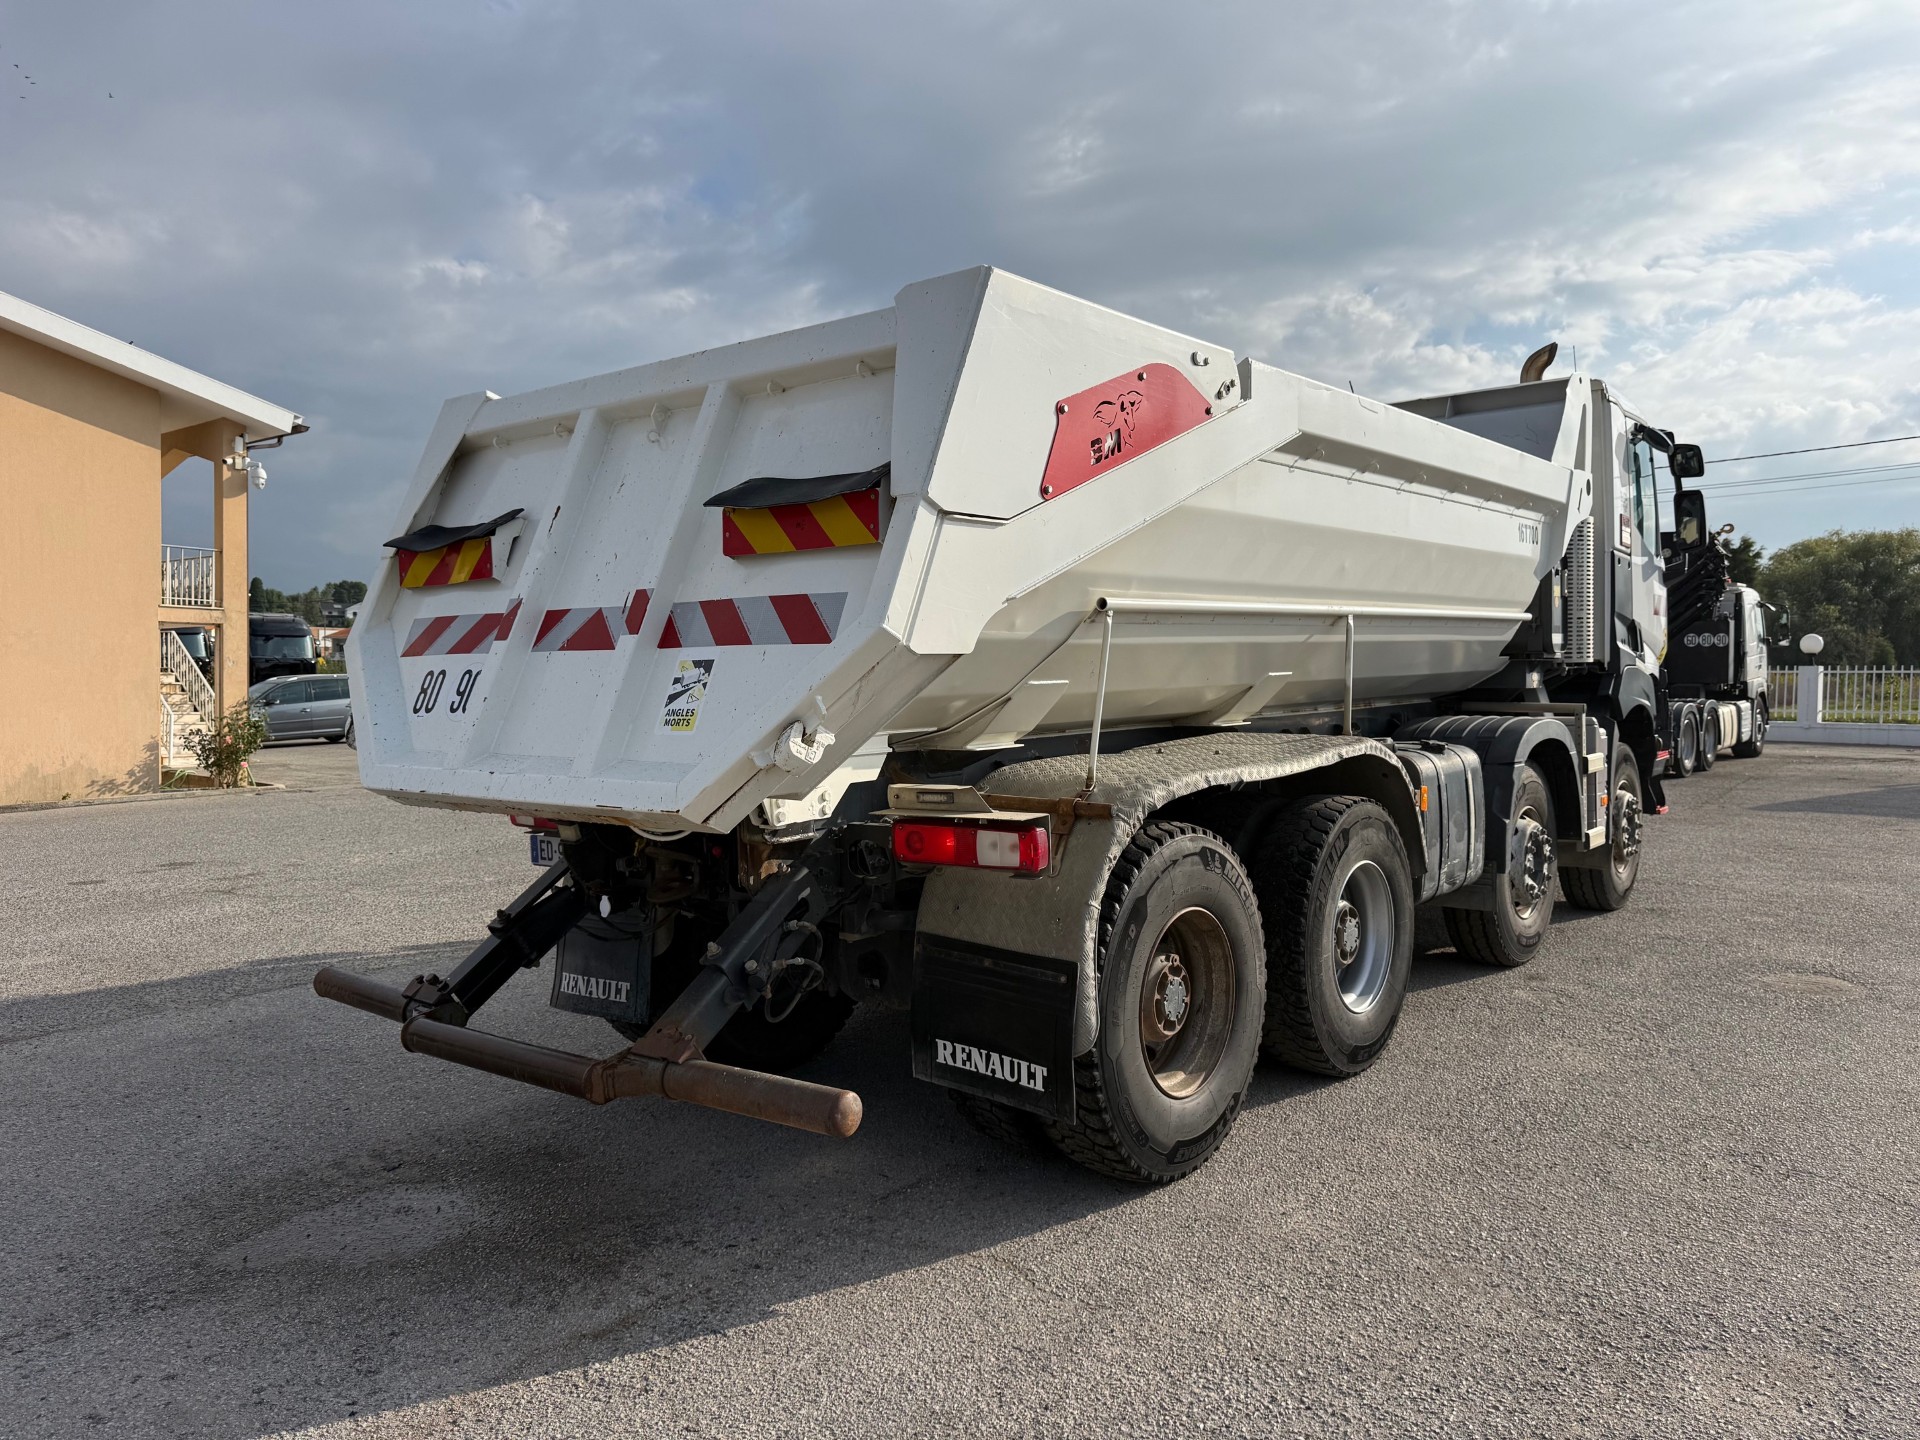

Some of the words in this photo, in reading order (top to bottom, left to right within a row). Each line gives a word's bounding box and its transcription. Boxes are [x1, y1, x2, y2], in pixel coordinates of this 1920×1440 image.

[1091, 428, 1122, 466] BM
[1686, 635, 1697, 646] 60
[1701, 634, 1712, 646] 80
[1716, 634, 1727, 646] 90
[413, 669, 447, 714] 80
[663, 718, 692, 727] MORTS
[664, 708, 696, 717] ANGLES
[560, 972, 631, 1003] RENAULT
[935, 1038, 1048, 1092] RENAULT
